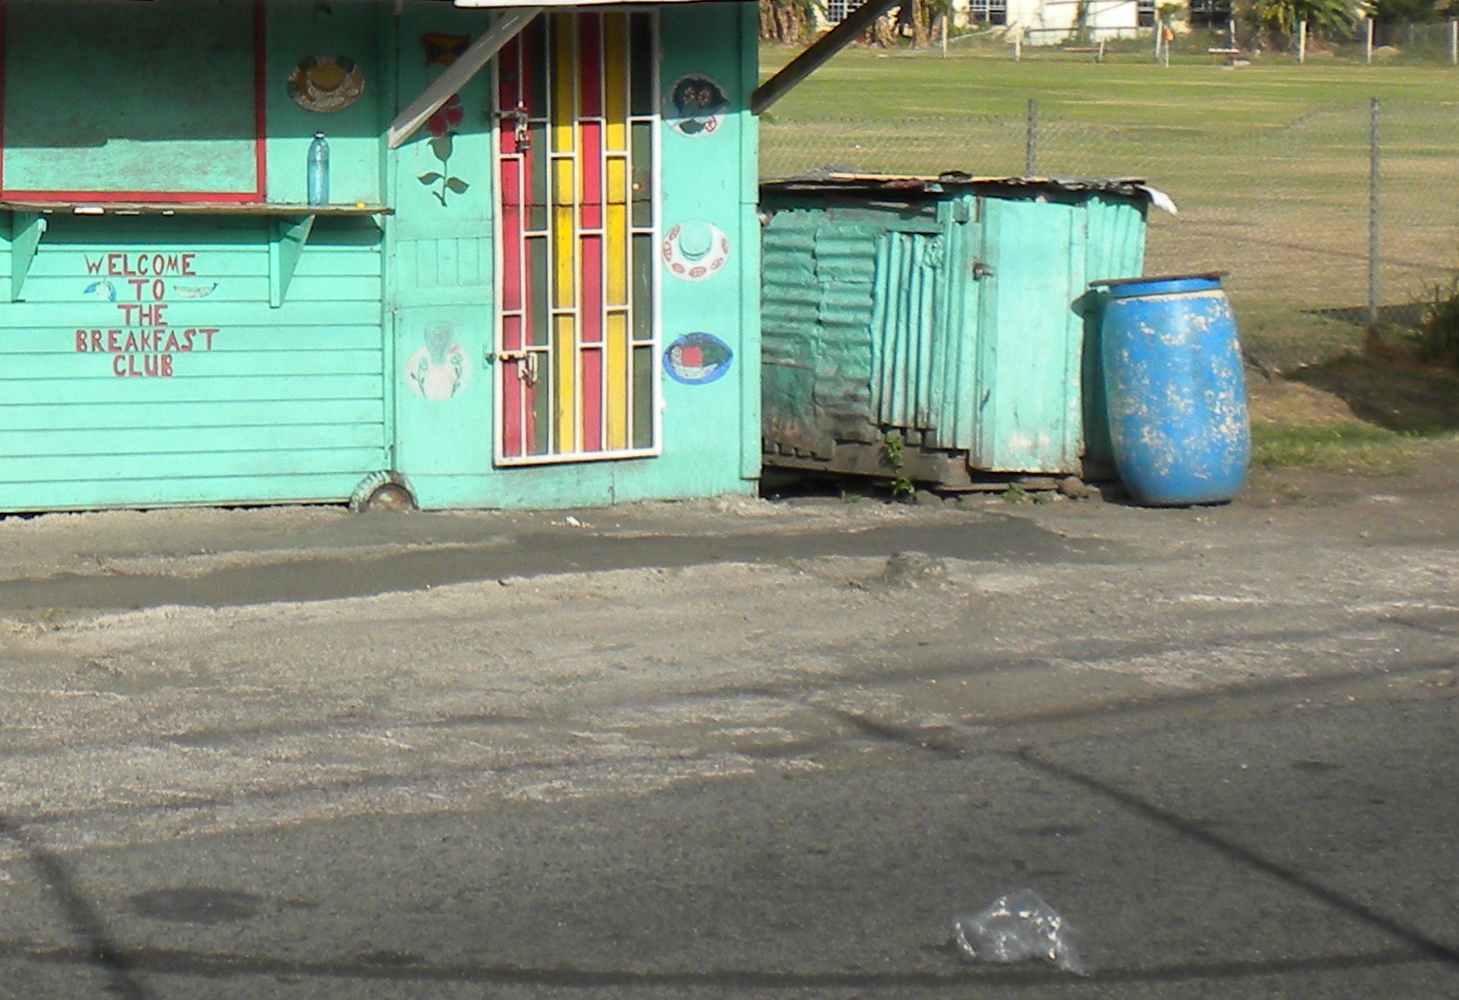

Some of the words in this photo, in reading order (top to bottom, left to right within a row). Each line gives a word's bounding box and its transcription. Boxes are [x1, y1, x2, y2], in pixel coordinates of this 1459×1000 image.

[84, 253, 196, 276] WELCOME
[128, 279, 165, 301] TO
[117, 304, 168, 326] THE
[75, 328, 220, 352] BREAKFAST
[113, 353, 173, 377] CLUB
